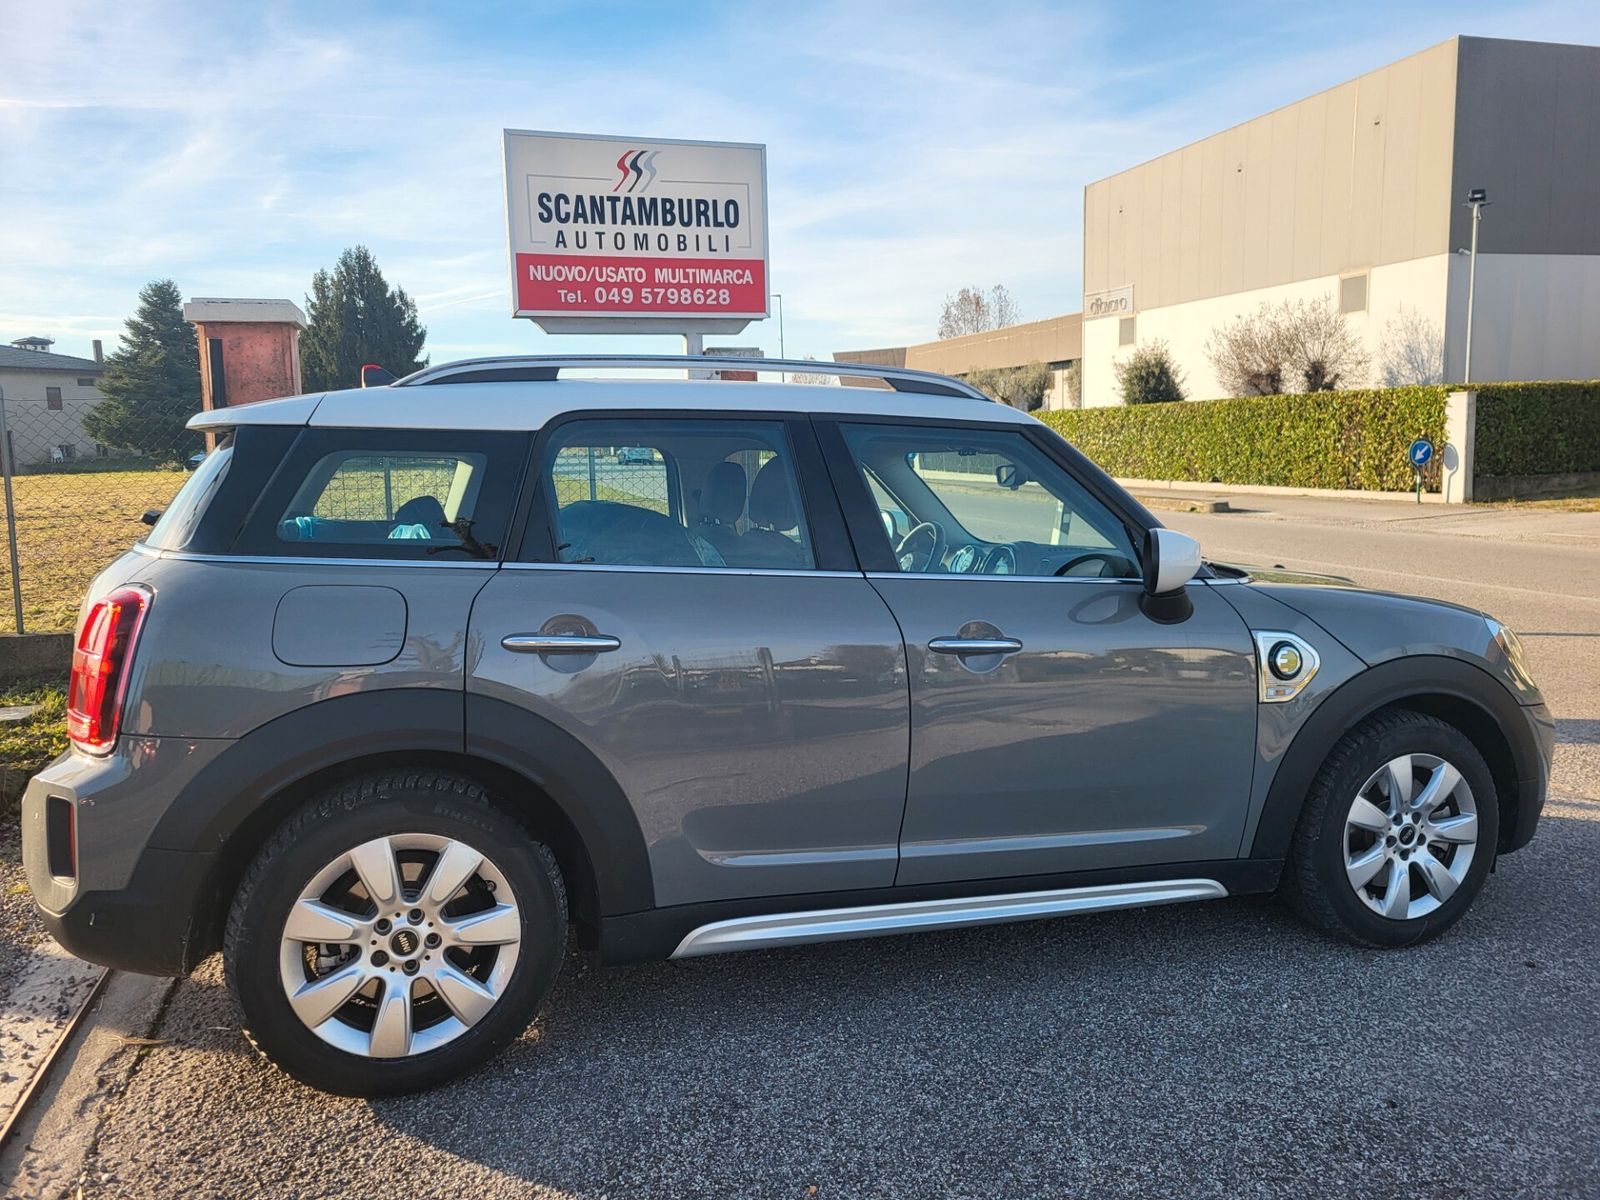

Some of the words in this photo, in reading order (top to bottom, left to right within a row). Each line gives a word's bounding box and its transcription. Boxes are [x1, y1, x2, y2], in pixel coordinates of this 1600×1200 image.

[537, 192, 740, 228] SCANTAMBURLO
[555, 230, 730, 252] AUTOMOBILI
[528, 264, 647, 283] NUOVO/USATO
[654, 267, 753, 284] MULTIMARCA
[557, 289, 587, 304] Tel.
[594, 287, 634, 304] 049
[641, 288, 731, 305] 5798628
[398, 933, 411, 953] MINI
